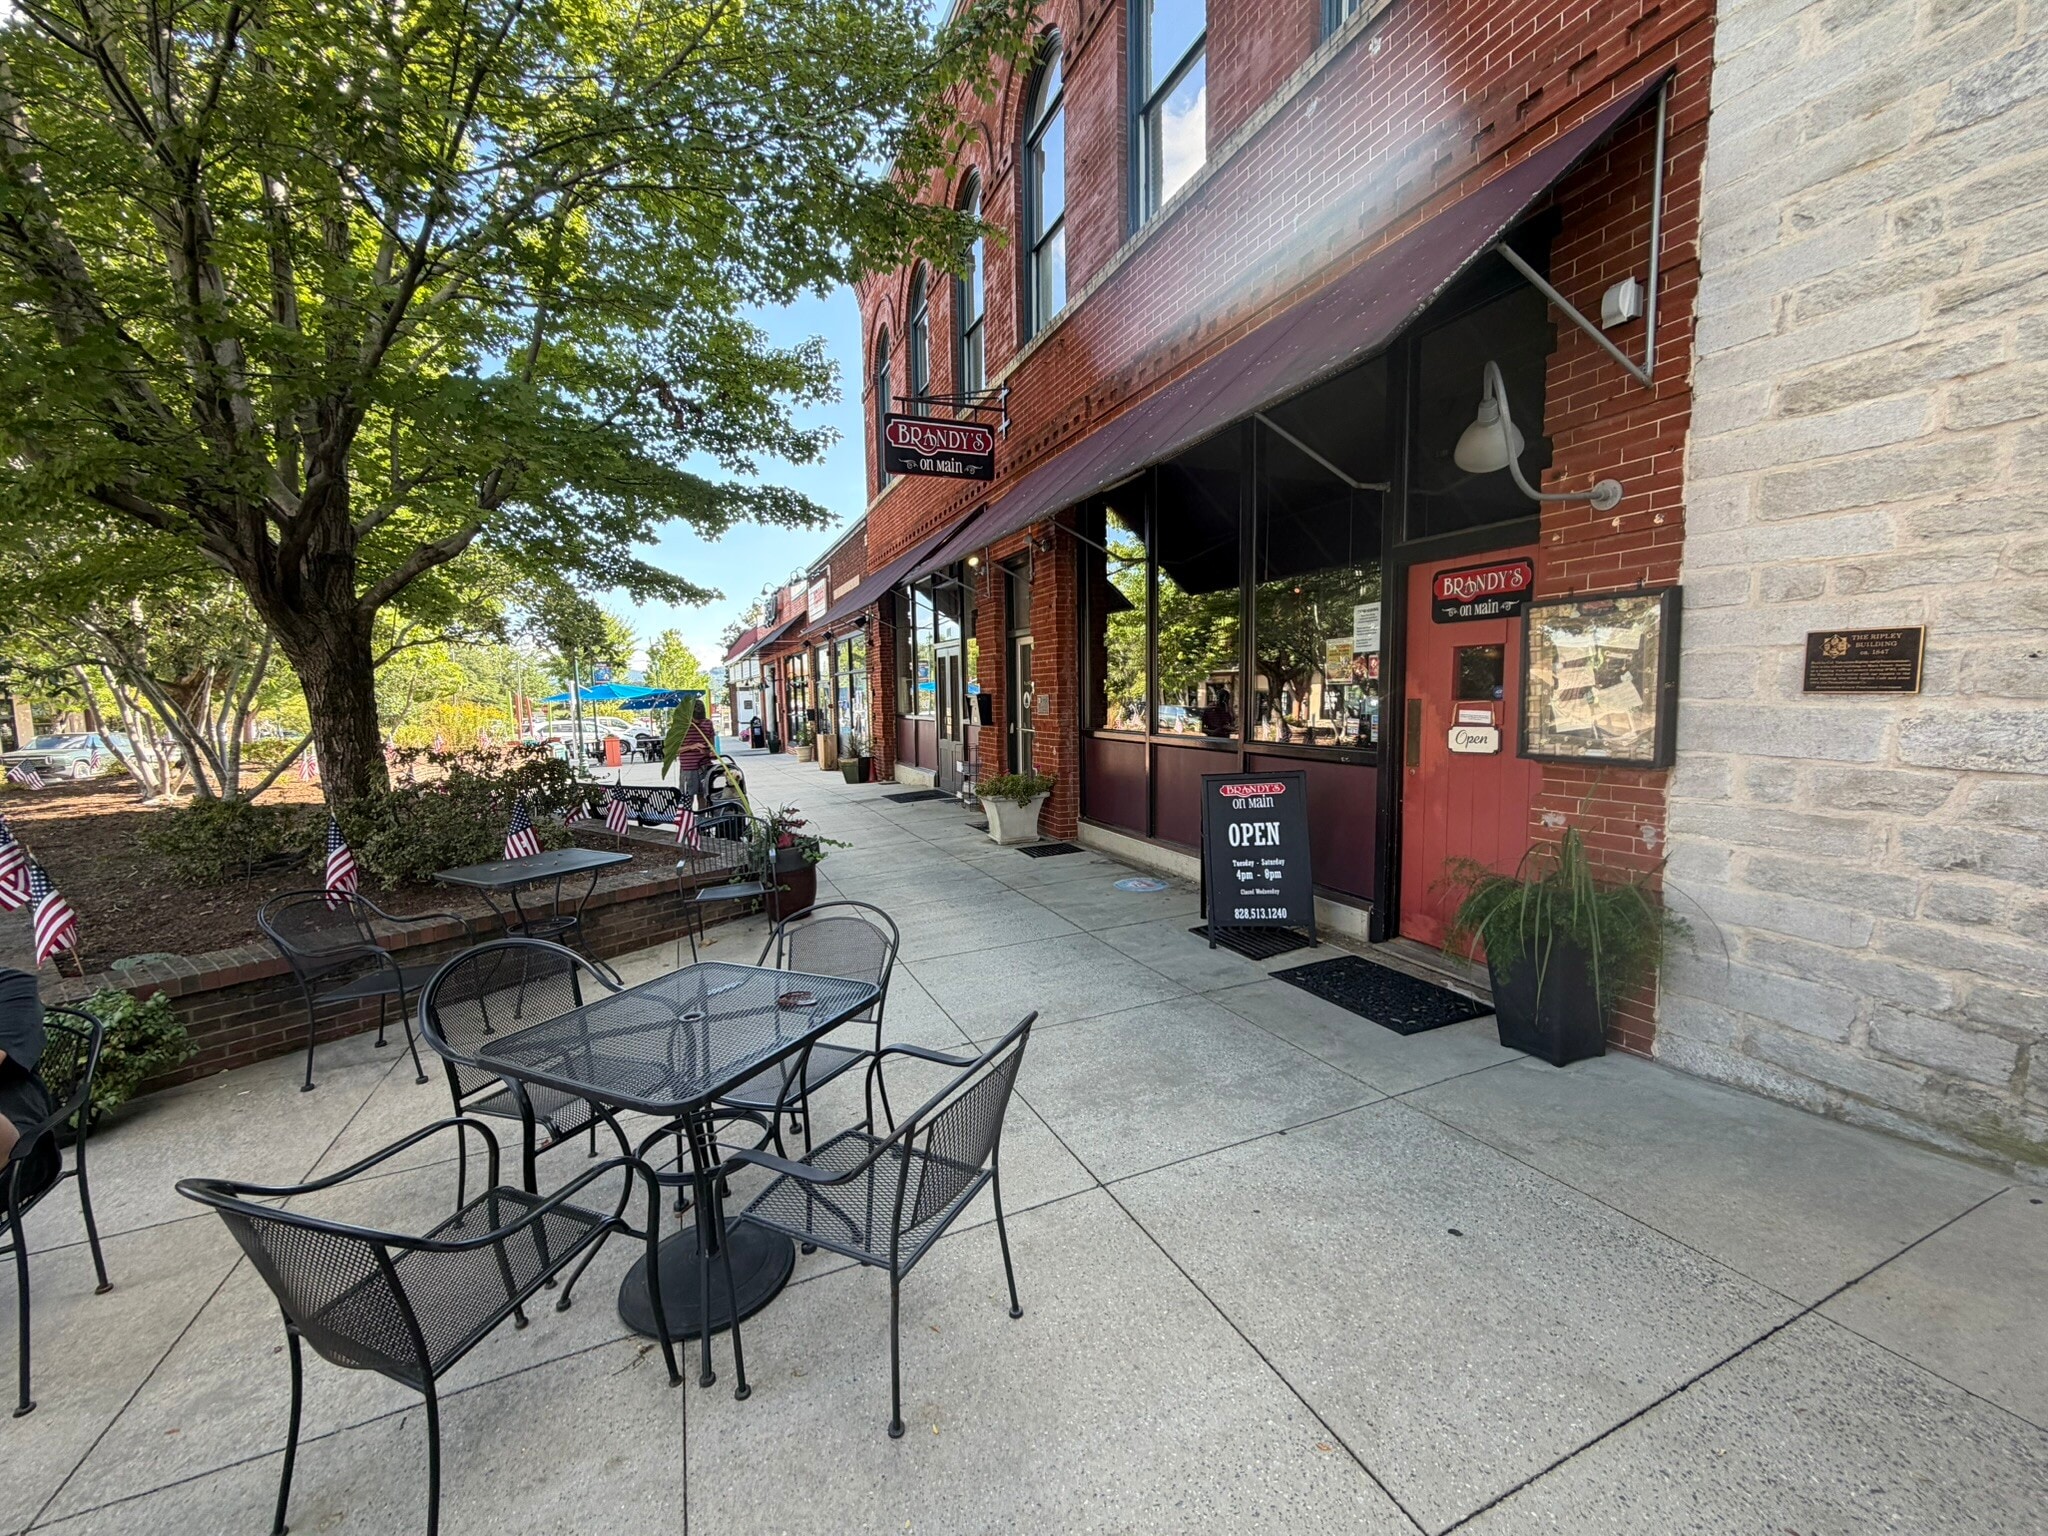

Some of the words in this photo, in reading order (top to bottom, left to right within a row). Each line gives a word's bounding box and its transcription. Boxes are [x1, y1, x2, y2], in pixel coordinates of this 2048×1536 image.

[898, 423, 985, 452] BRANDY'S
[919, 457, 934, 471] on
[936, 457, 963, 474] Main
[1443, 568, 1523, 598] BRANDY'S
[1460, 604, 1472, 617] on
[1474, 599, 1499, 615] Main
[1855, 640, 1898, 648] BUILDING
[1455, 729, 1488, 749] Open
[1226, 784, 1281, 796] BRANDY'S
[1232, 798, 1246, 809] on
[1248, 794, 1274, 808] Main
[1228, 821, 1280, 847] OPEN
[1232, 859, 1255, 868] Tuesday
[1261, 858, 1285, 867] Saturday
[1236, 869, 1253, 882] 4pm
[1234, 907, 1288, 920] 828.513.1240
